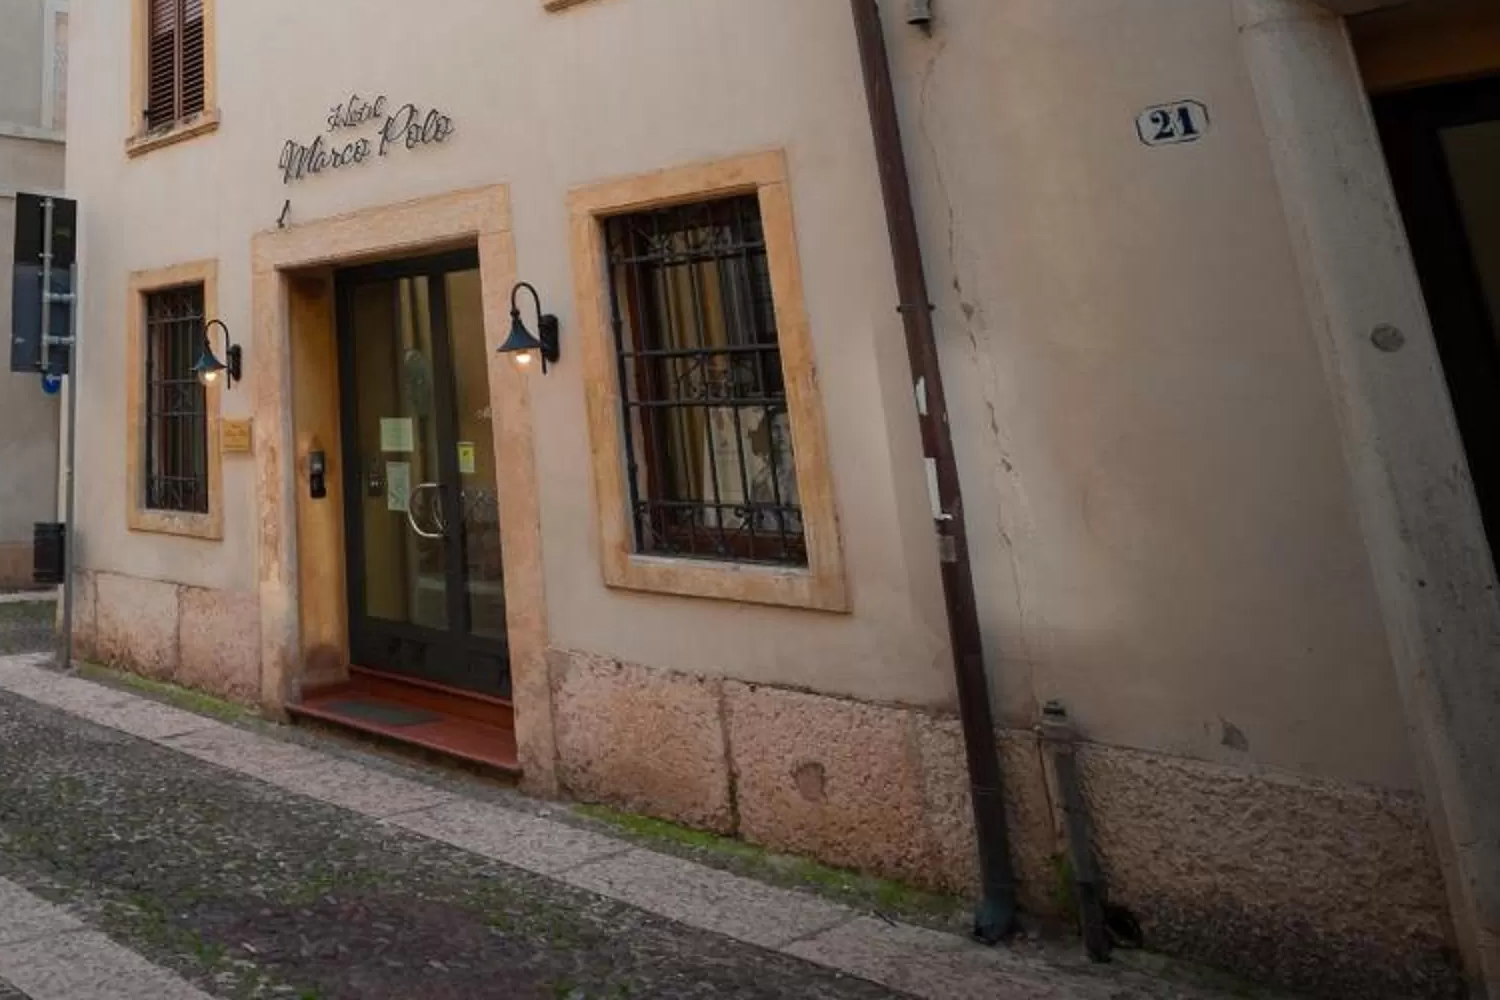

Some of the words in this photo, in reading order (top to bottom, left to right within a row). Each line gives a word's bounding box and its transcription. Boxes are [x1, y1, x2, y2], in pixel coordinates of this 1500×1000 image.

[279, 135, 371, 184] Marco
[378, 103, 455, 156] Polo
[1150, 106, 1199, 139] 21
